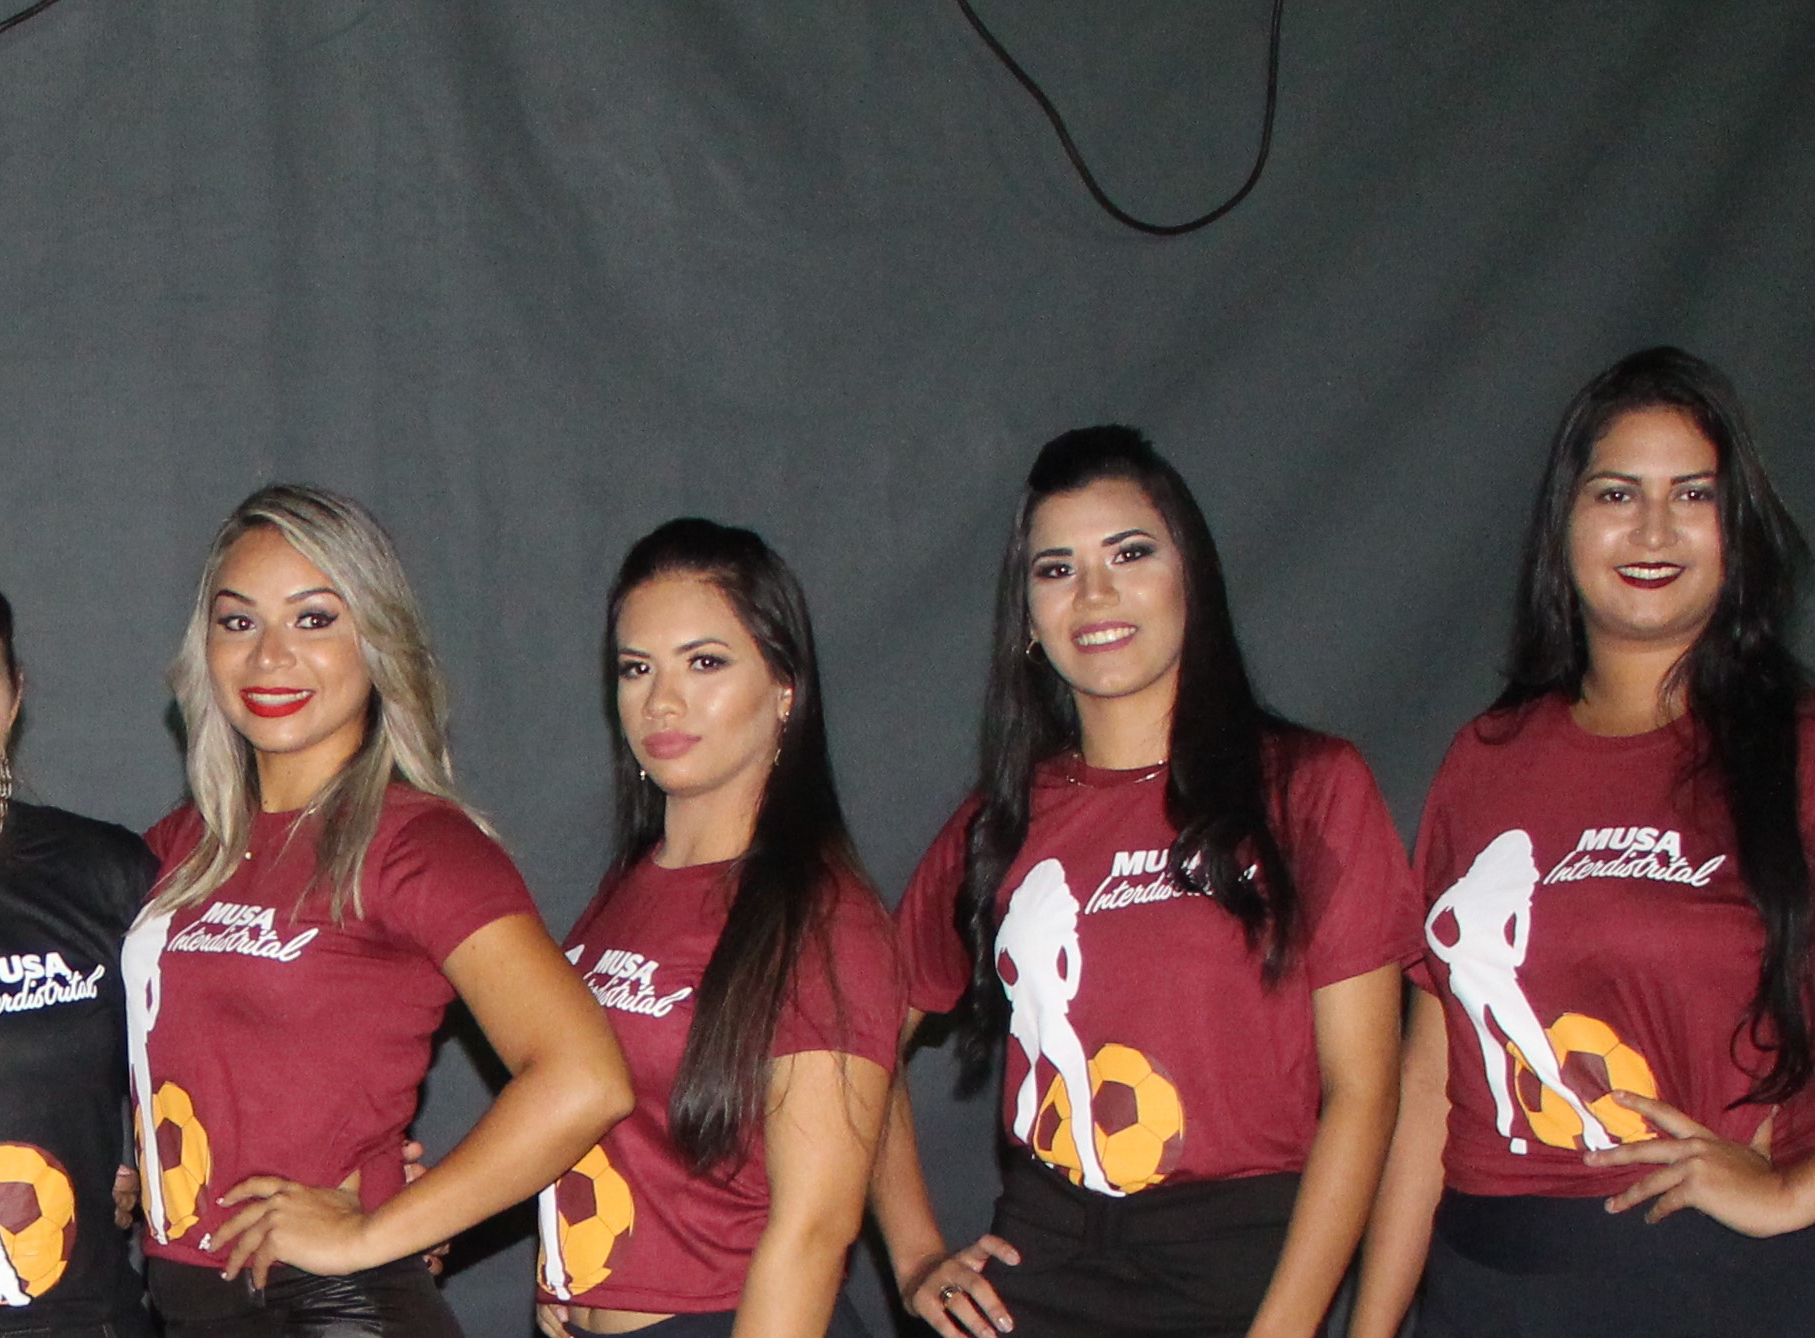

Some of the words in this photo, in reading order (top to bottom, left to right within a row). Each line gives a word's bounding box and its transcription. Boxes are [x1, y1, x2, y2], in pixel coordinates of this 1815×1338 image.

[1577, 827, 1680, 862] MUSA
[1542, 843, 1726, 887] Interdistrital
[200, 901, 276, 932] MUSA
[167, 920, 319, 962] Interdistrital
[593, 949, 659, 987] MUSA
